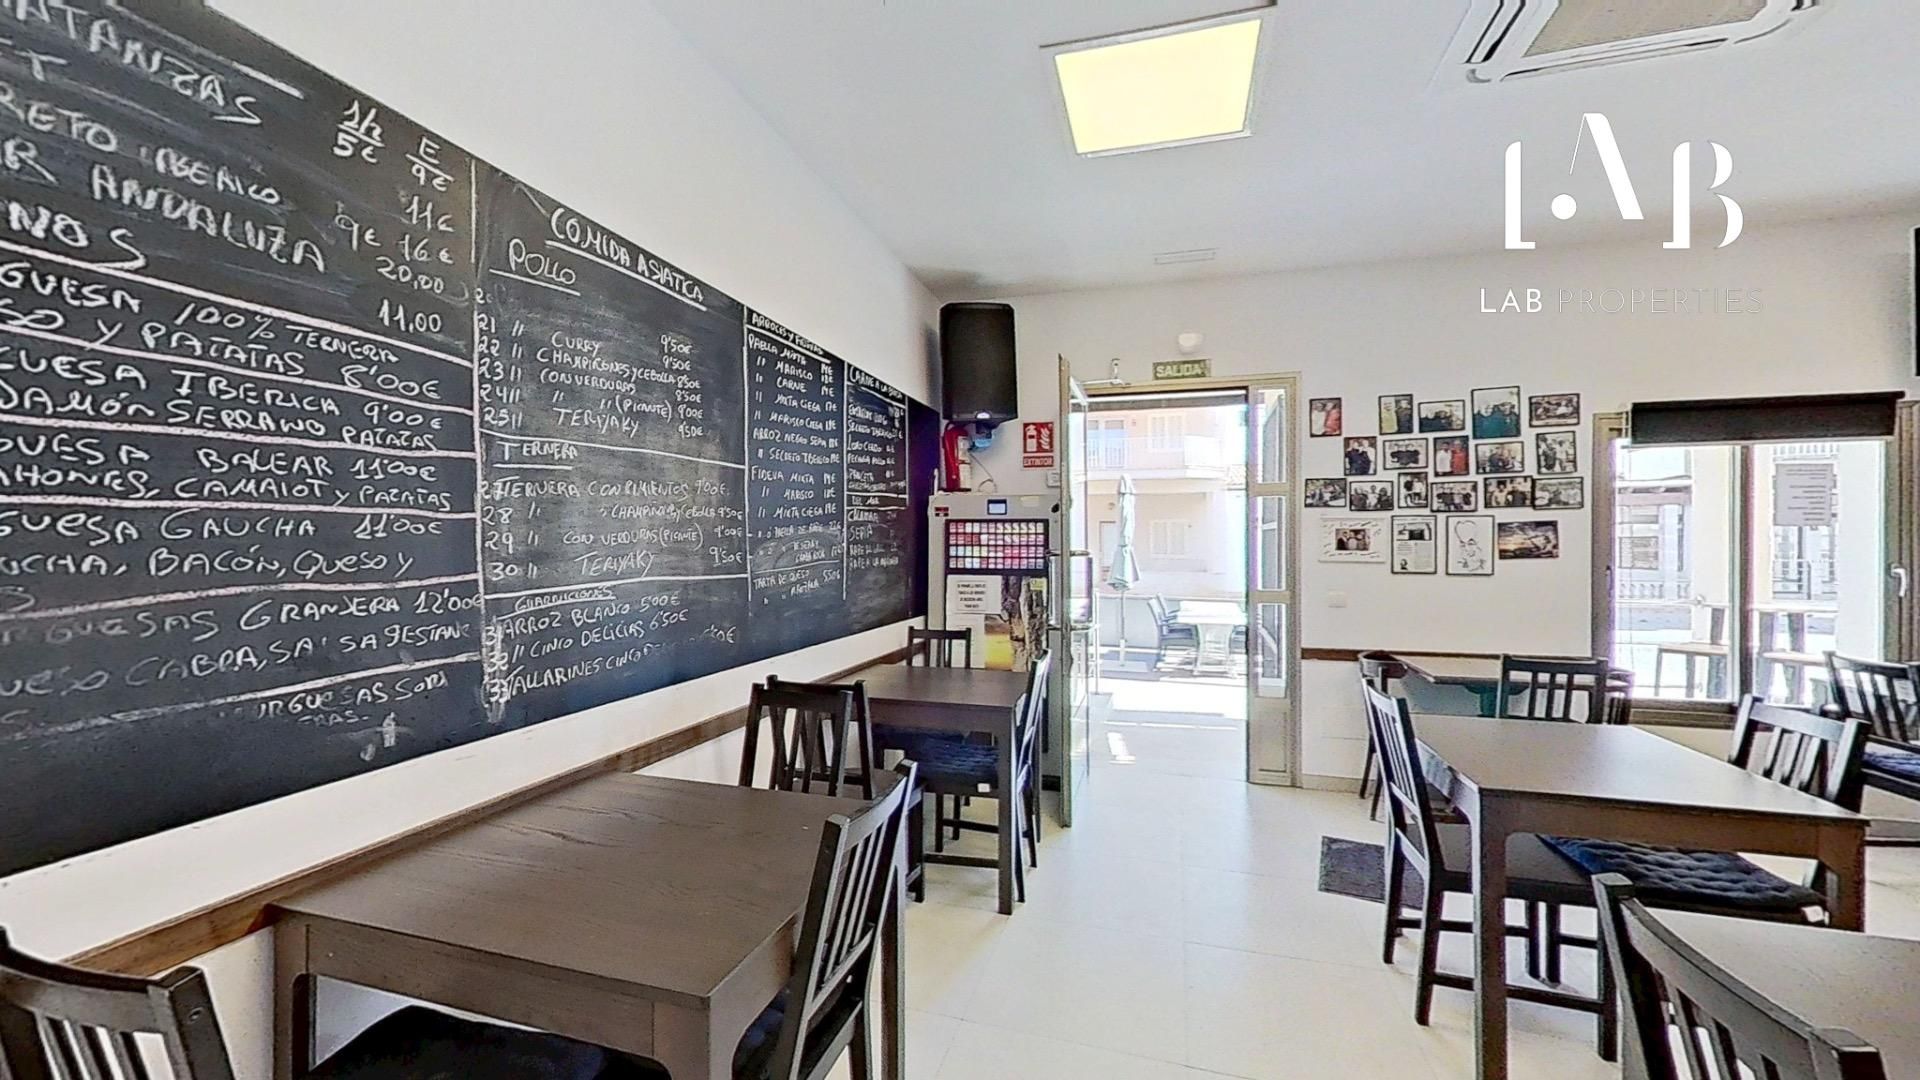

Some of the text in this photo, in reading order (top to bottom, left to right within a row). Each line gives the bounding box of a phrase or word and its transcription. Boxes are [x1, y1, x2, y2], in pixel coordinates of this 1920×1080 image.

[410, 163, 449, 191] 9€
[91, 164, 325, 272] ANDALUZA
[405, 196, 454, 232] 11€
[508, 238, 576, 285] POLLO
[551, 207, 704, 303] COMIDA ASIATICA
[378, 299, 442, 333] 11,00
[174, 303, 275, 341] 100%
[286, 324, 399, 362] TERNERA
[477, 313, 496, 333] 21
[551, 331, 600, 357] CURRY
[478, 336, 500, 358] 22
[140, 322, 305, 376] PATATAS
[479, 357, 505, 381] 23
[540, 368, 572, 385] CON
[574, 374, 637, 395] VERDURAS
[775, 361, 813, 380] MARISCO
[776, 376, 807, 393] CARNE
[1156, 363, 1202, 377] SALIDA
[170, 369, 341, 415] IBERICA
[363, 401, 443, 436] 9'00€
[480, 384, 508, 404] 24
[167, 399, 325, 437] SERRANO
[342, 426, 438, 452] PATATAS
[483, 406, 509, 426] 25
[769, 411, 804, 427] MARISCO
[496, 441, 578, 461] TERNERA
[753, 428, 781, 443] ARROZ
[197, 445, 334, 478] BALEAR
[769, 447, 800, 462] SECRETO
[174, 477, 330, 499] CAMAIOT
[359, 485, 452, 512] PATATAS
[588, 481, 621, 497] CON
[625, 481, 689, 502] PIMIENTOS
[160, 508, 317, 540] GAUCHA
[482, 505, 513, 525] 28
[484, 530, 514, 554] 29
[601, 528, 657, 546] VERDURAS
[489, 562, 518, 581] 30
[574, 550, 656, 578] TERIYAKY
[240, 600, 401, 631] GRANJERA
[503, 612, 562, 640] ARROZ
[571, 604, 631, 627] BLANCO
[529, 638, 574, 658] CINCO
[581, 620, 645, 648] DELICIAS
[506, 656, 602, 699] TALLARINES
